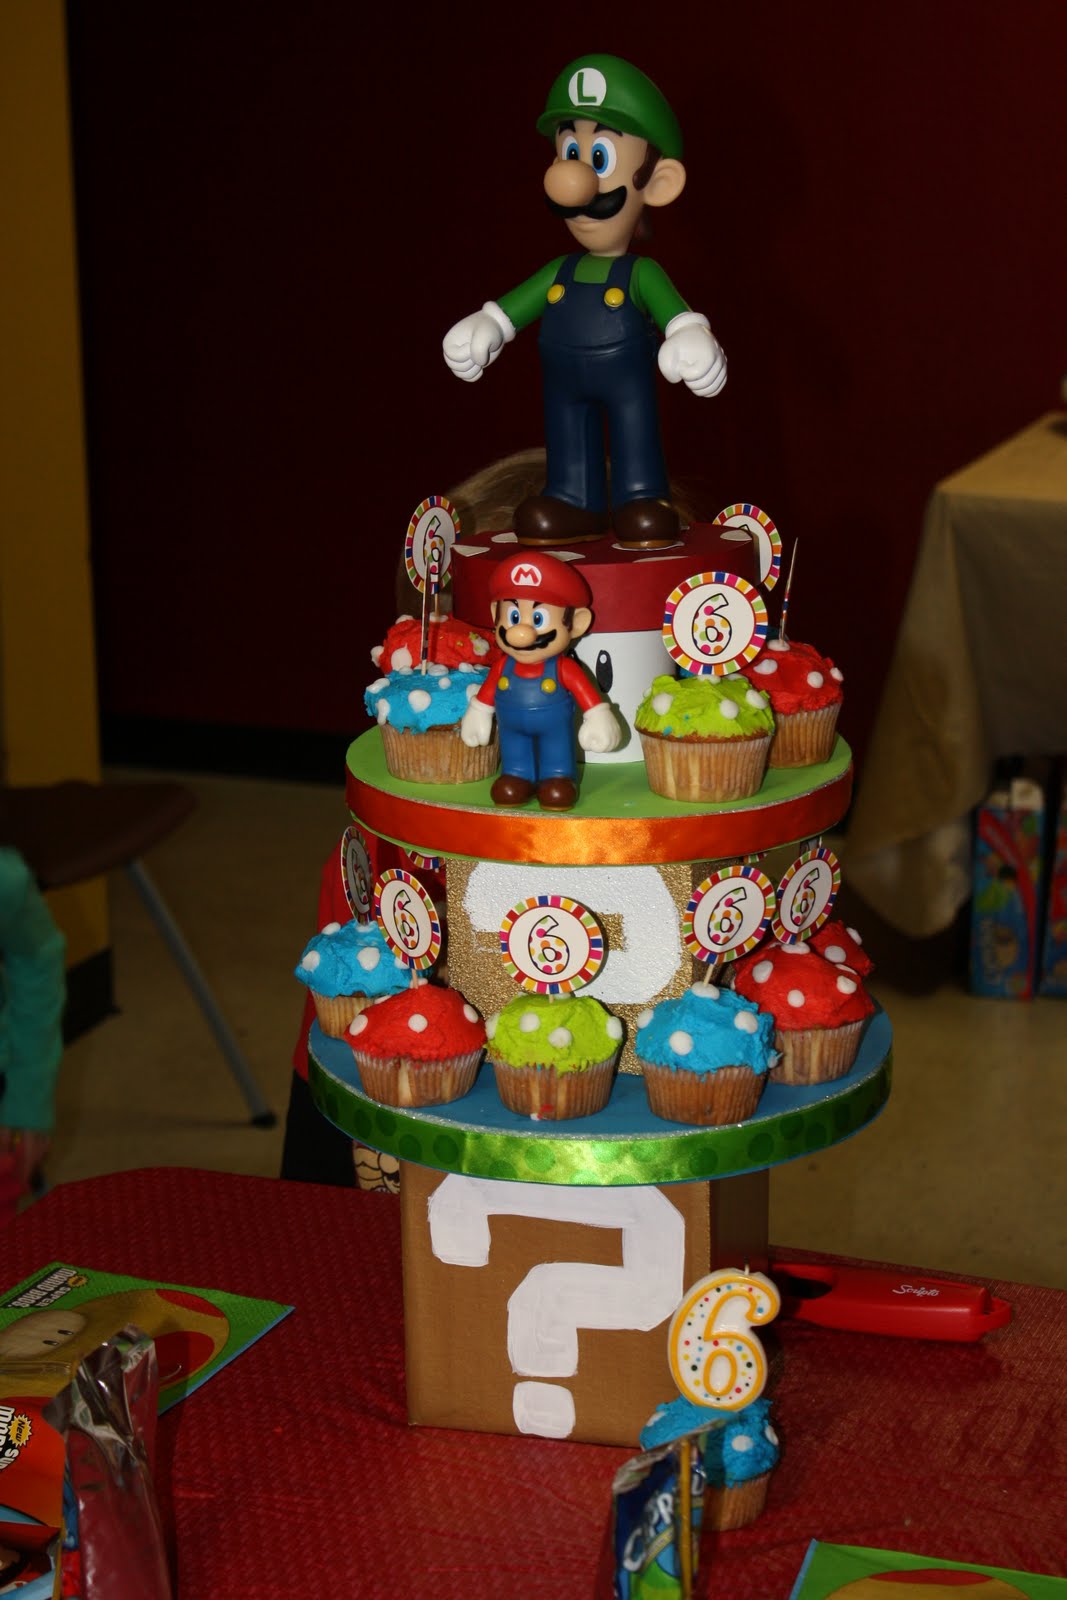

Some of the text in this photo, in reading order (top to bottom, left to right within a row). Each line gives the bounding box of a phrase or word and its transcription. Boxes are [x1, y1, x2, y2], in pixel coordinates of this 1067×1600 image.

[577, 71, 598, 104] L
[513, 566, 540, 585] M
[691, 592, 733, 657] 6
[392, 889, 420, 950] 6
[706, 886, 748, 946] 6
[789, 866, 820, 927] 6
[527, 914, 571, 976] 6
[668, 1267, 781, 1412] 6
